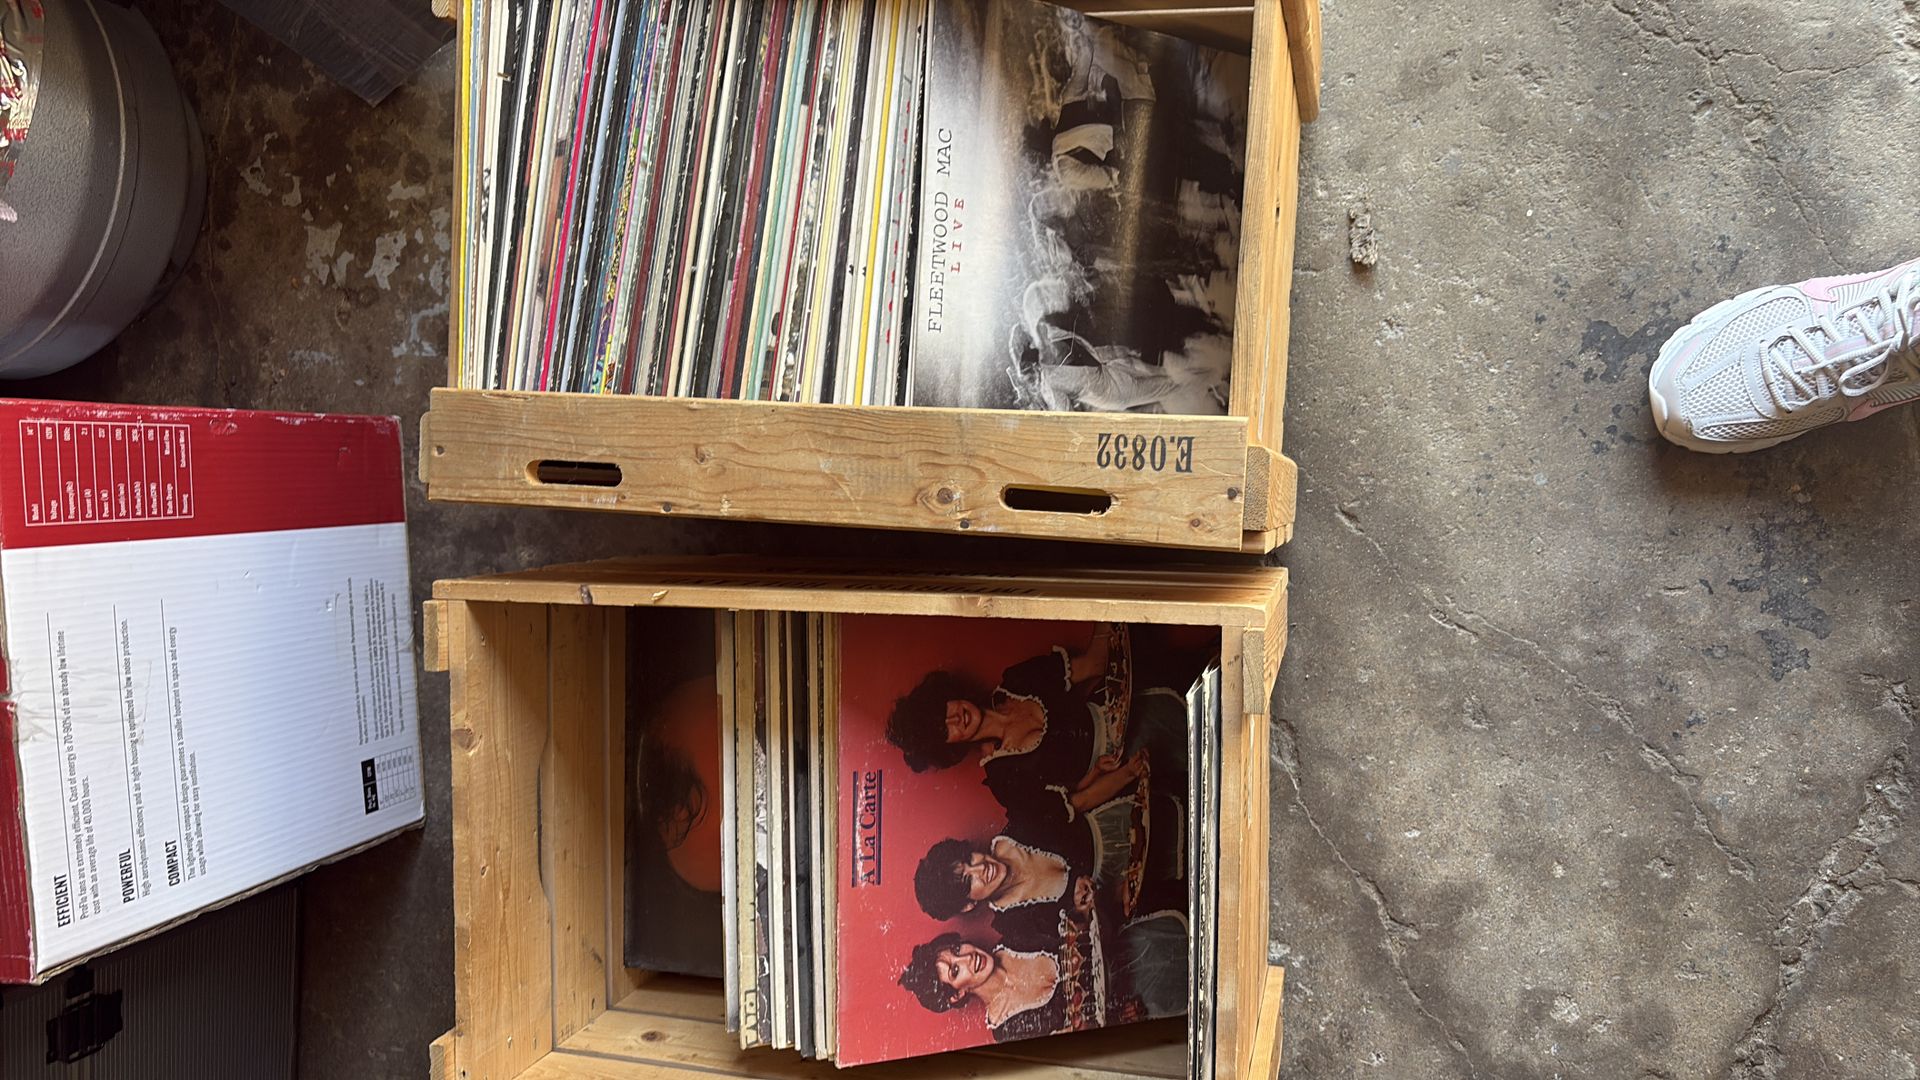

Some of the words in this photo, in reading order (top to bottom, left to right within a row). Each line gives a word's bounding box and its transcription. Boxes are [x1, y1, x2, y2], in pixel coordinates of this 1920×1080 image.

[936, 128, 952, 176] MAC
[951, 197, 964, 273] LIVE
[928, 191, 948, 333] FLEETWOOD
[1096, 433, 1195, 473] E.0832
[54, 630, 65, 656] lifetime
[118, 618, 130, 656] production.
[168, 626, 177, 647] energy
[57, 658, 66, 670] low
[168, 648, 177, 660] and
[122, 657, 131, 675] noise
[171, 661, 179, 680] space
[58, 671, 70, 696] already
[123, 676, 132, 688] low
[124, 689, 133, 698] for
[61, 707, 70, 715] of
[62, 697, 69, 706] an
[171, 689, 182, 716] footprint
[125, 699, 136, 731] optimized
[61, 716, 72, 743] 70-90%
[174, 717, 183, 740] smaller
[128, 738, 140, 765] housing
[67, 753, 77, 775] energy
[178, 747, 188, 781] guarantees
[68, 786, 78, 801] Cost
[79, 776, 90, 798] hours.
[132, 782, 140, 791] air
[133, 792, 142, 804] and
[179, 782, 190, 803] design
[192, 786, 200, 801] easy
[81, 798, 93, 824] 40,000
[859, 771, 876, 830] Carte
[70, 802, 81, 832] efficient.
[134, 805, 146, 837] efficiency
[182, 804, 192, 831] compact
[192, 812, 203, 838] allowing
[84, 825, 93, 833] of
[84, 834, 94, 846] life
[73, 833, 85, 866] extremely
[137, 838, 150, 879] aerodynamic
[184, 832, 196, 866] lightweight
[195, 839, 203, 855] while
[859, 835, 875, 862] La
[88, 846, 98, 872] average
[165, 839, 180, 886] COMPACT
[198, 856, 207, 875] usage
[90, 873, 97, 882] an
[119, 848, 135, 904] POWERFUL
[187, 867, 195, 880] The
[860, 868, 875, 885] A
[77, 880, 86, 895] fans
[89, 883, 99, 898] with
[141, 880, 152, 896] High
[54, 873, 70, 928] EFFICIENT
[78, 895, 89, 919] ProFlo
[91, 899, 100, 914] cost
